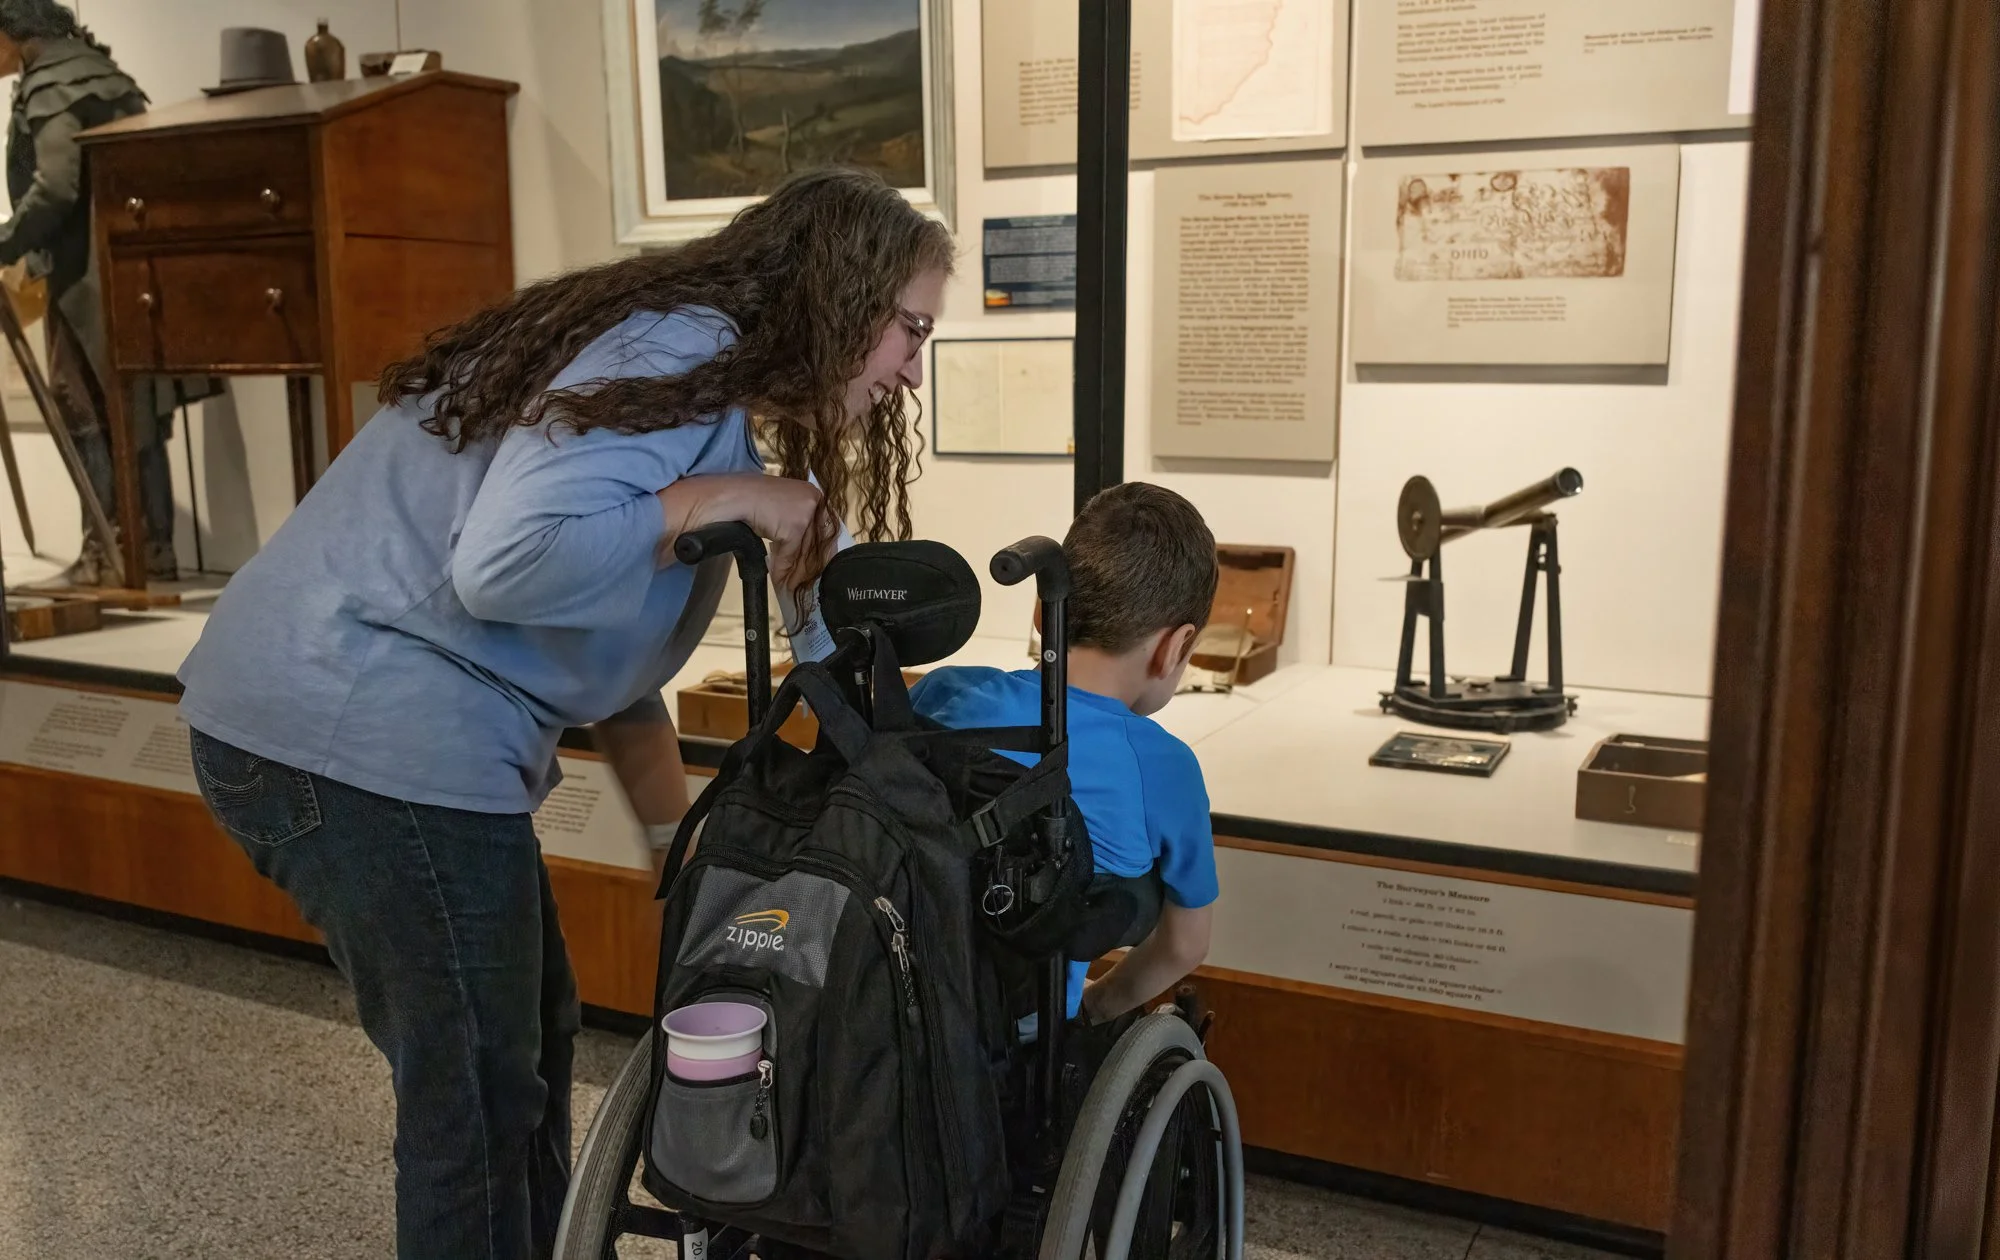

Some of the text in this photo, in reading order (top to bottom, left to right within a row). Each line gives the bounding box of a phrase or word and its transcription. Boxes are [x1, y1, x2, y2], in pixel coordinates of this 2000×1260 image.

[847, 587, 906, 601] WHITMYER
[1376, 879, 1393, 889] The
[1448, 889, 1489, 903] Measure
[726, 926, 784, 951] zippie
[692, 1241, 703, 1260] 20.
